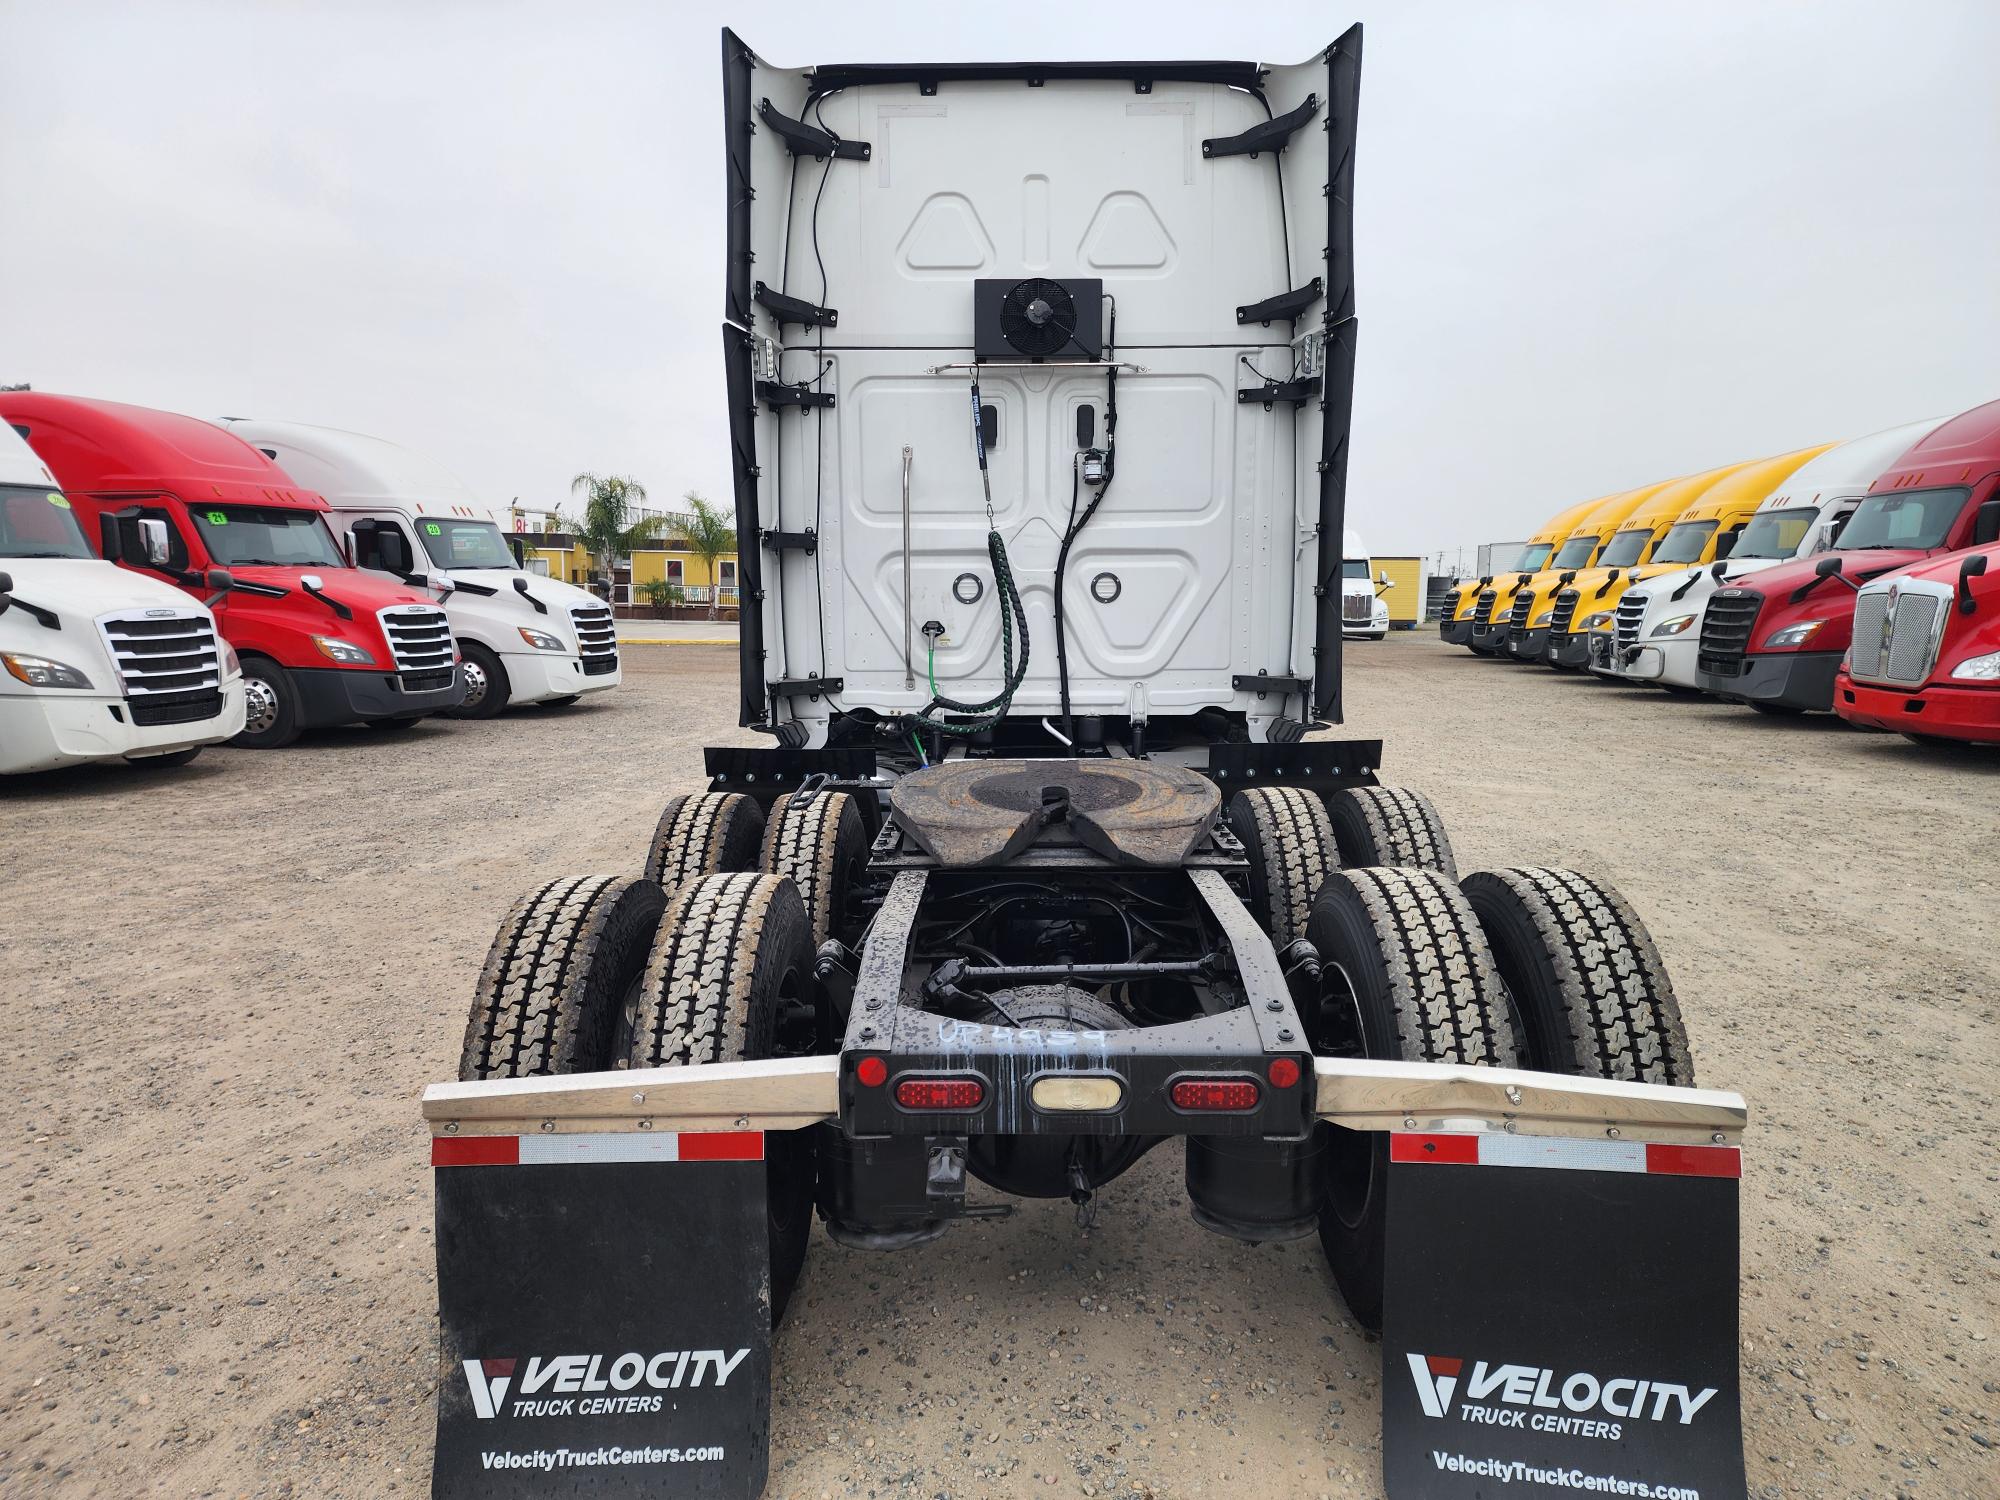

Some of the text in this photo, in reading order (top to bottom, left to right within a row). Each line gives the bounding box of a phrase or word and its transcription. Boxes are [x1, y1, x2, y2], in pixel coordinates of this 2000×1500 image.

[972, 395, 981, 427] PHILLIPS
[212, 513, 224, 522] 21
[519, 1349, 751, 1394] VELOCITY
[513, 1396, 663, 1417] TRUCK CENTERS
[1467, 1361, 1718, 1424] VELOCITY
[1460, 1404, 1622, 1440] TRUCK CENTERS
[481, 1446, 724, 1471] VelocityTruckCenters.com
[1433, 1451, 1699, 1500] VelocityTruckCenters.com
